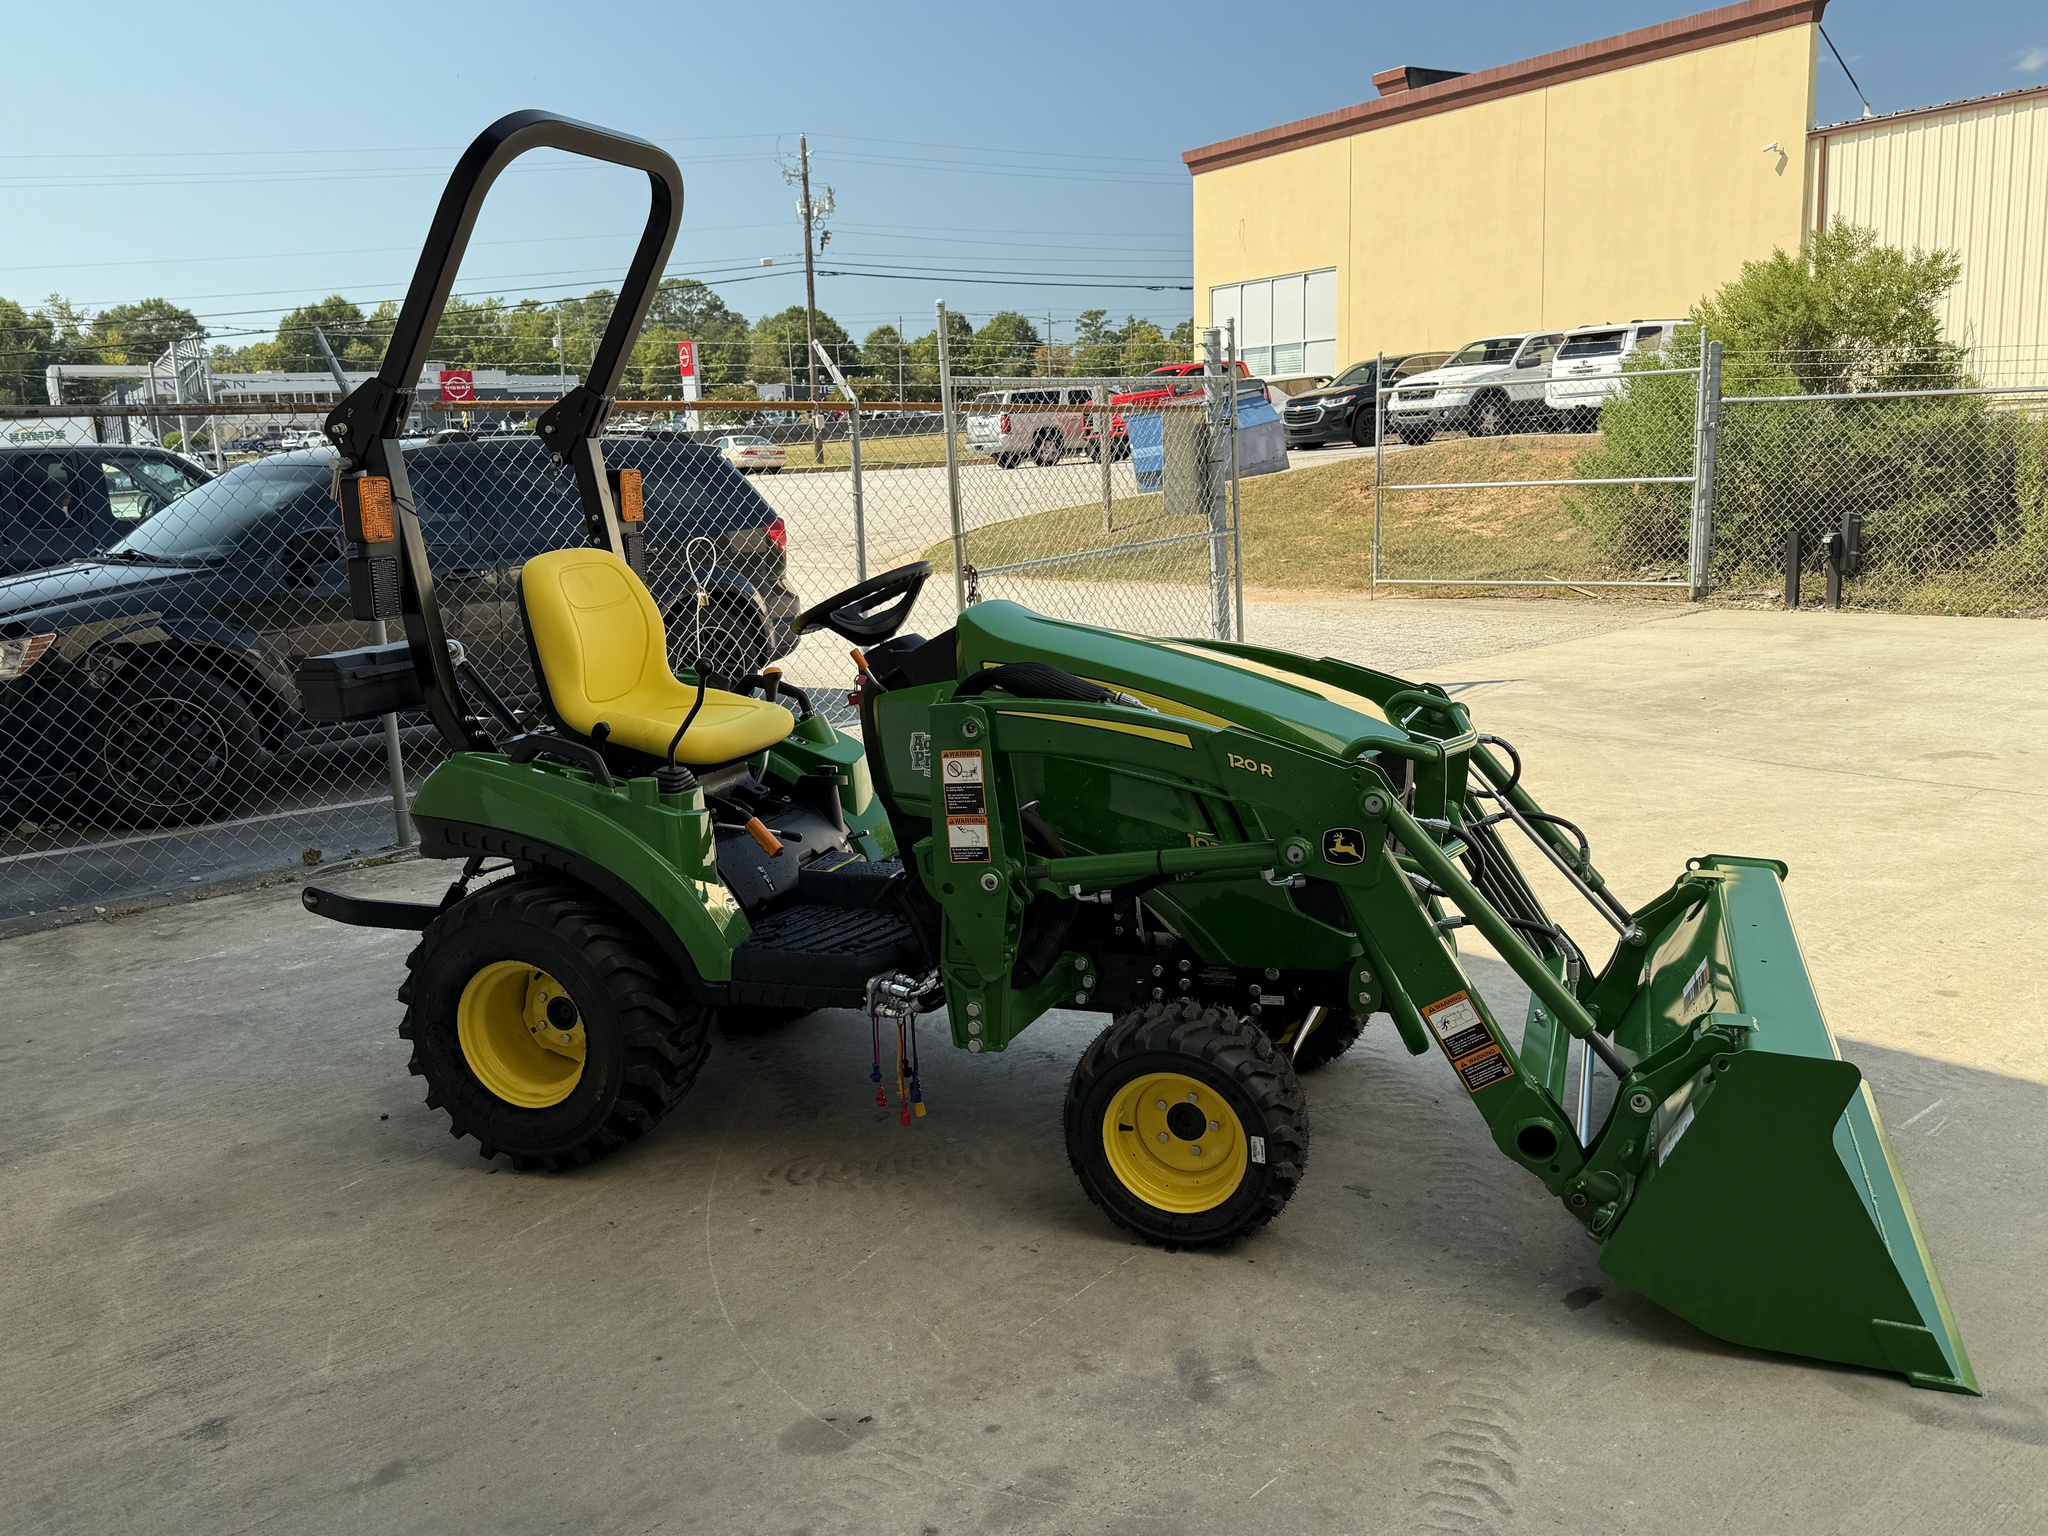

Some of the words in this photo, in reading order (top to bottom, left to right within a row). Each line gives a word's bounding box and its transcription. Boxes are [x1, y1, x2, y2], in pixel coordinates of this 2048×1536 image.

[163, 380, 246, 390] NAN
[1227, 753, 1257, 772] 120
[1261, 763, 1274, 778] R
[1434, 994, 1462, 1010] WARNING
[1467, 1048, 1496, 1064] WARNING
